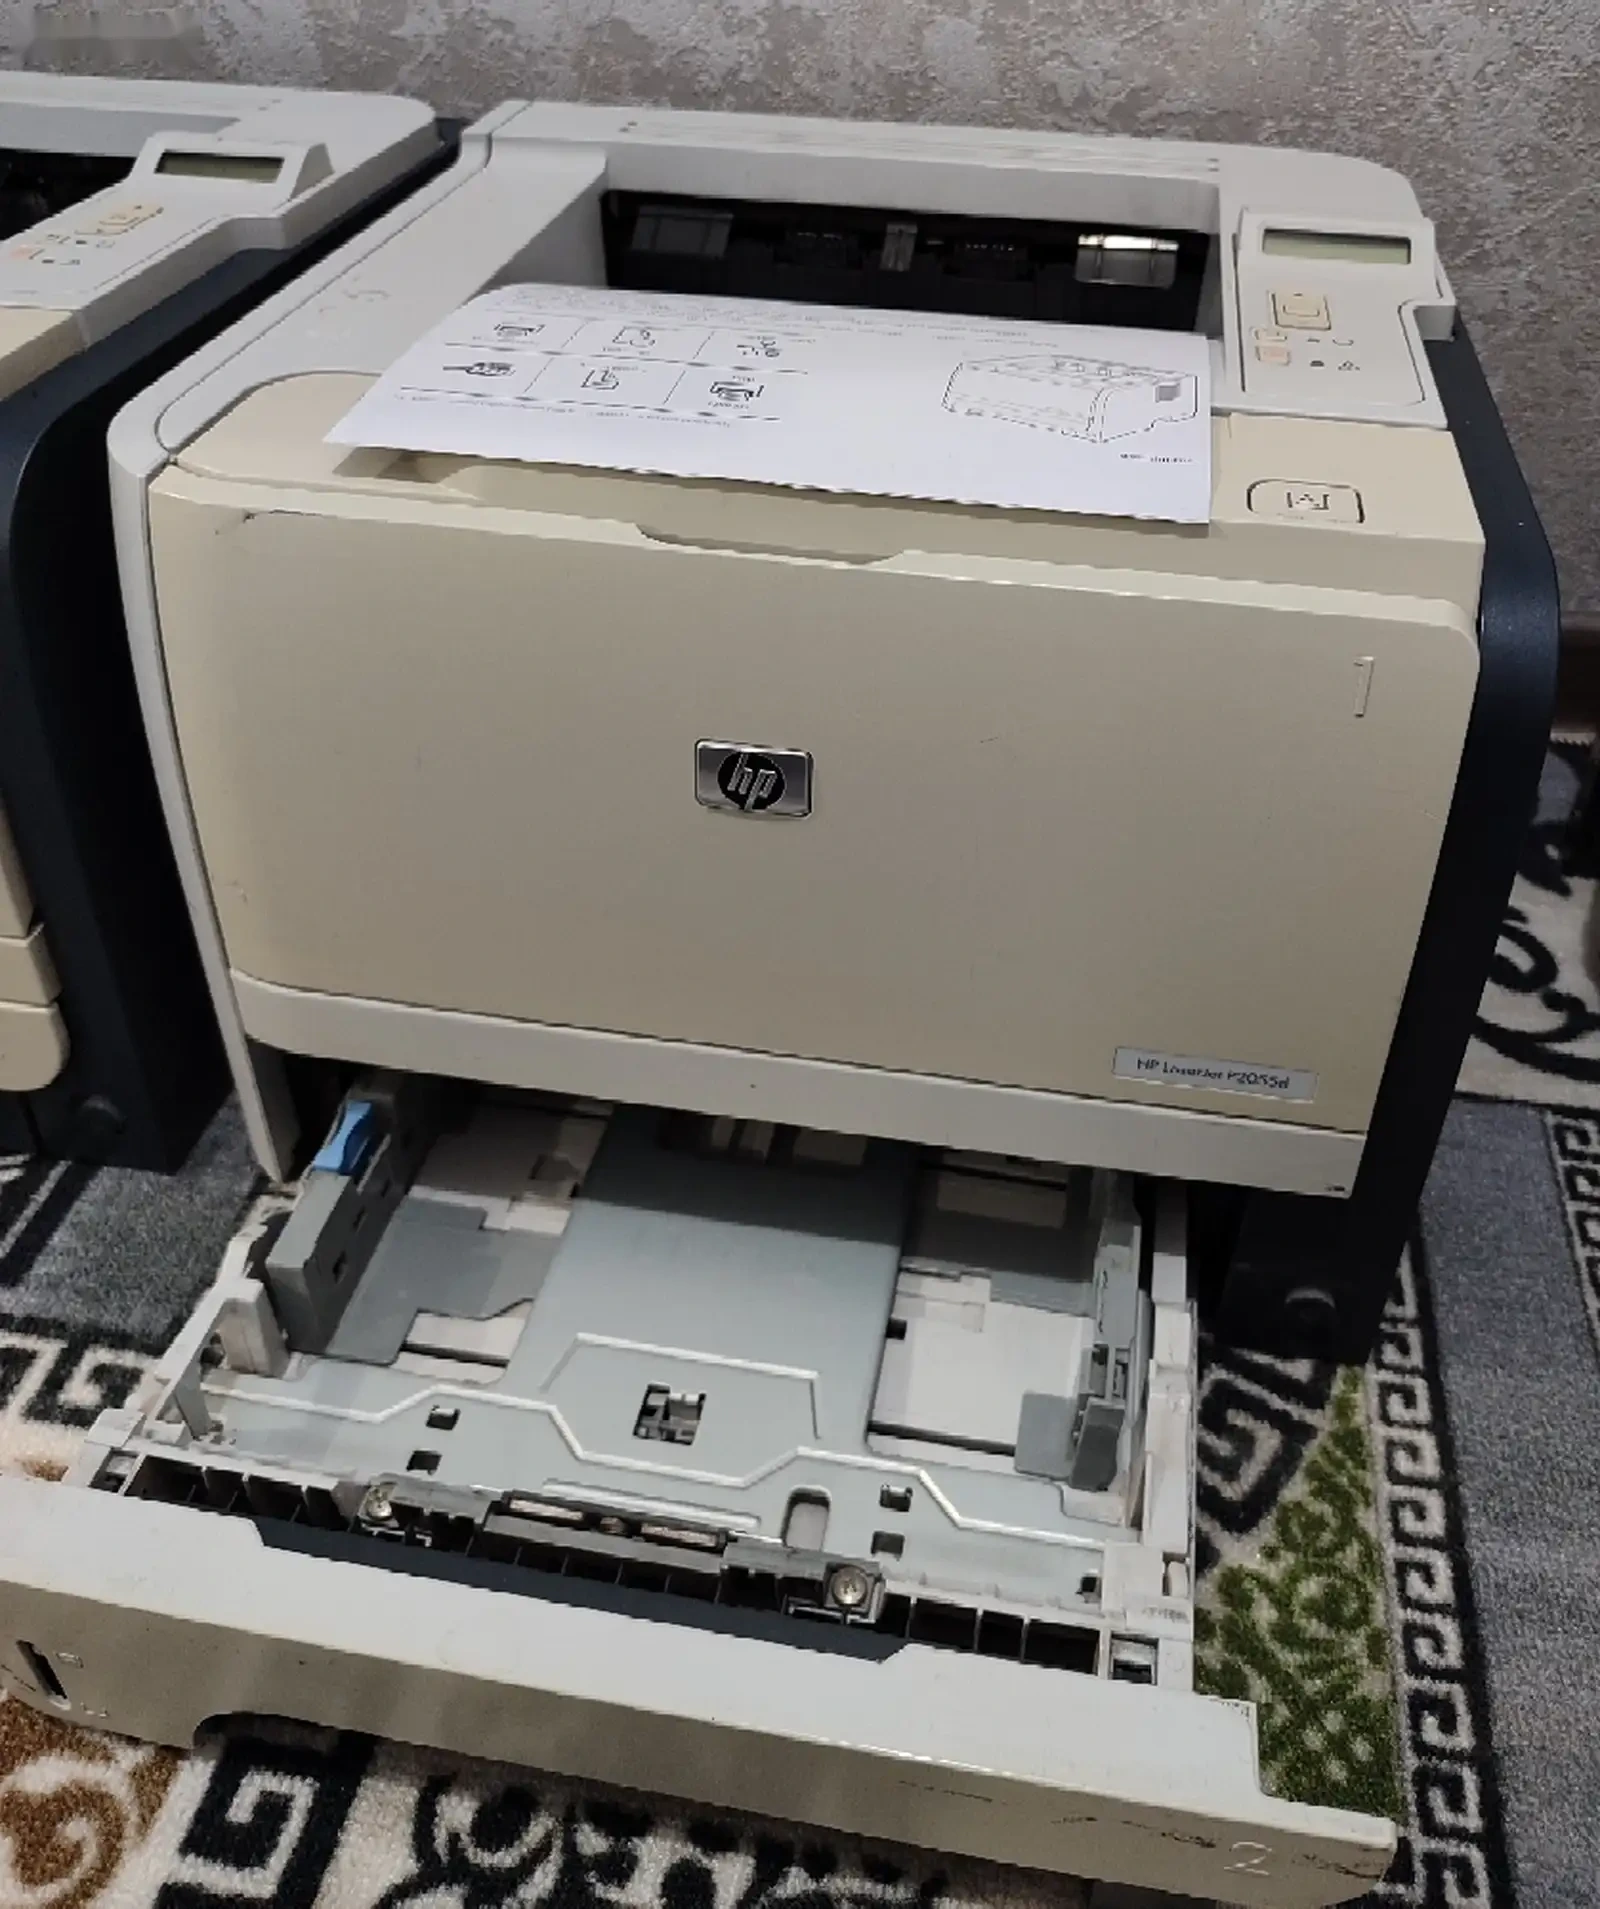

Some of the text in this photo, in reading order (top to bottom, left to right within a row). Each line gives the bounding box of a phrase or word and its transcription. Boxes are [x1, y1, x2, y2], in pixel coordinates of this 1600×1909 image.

[726, 752, 778, 812] hp
[1136, 1057, 1291, 1090] HP LaserJet P2055d
[1223, 1840, 1273, 1876] 2
